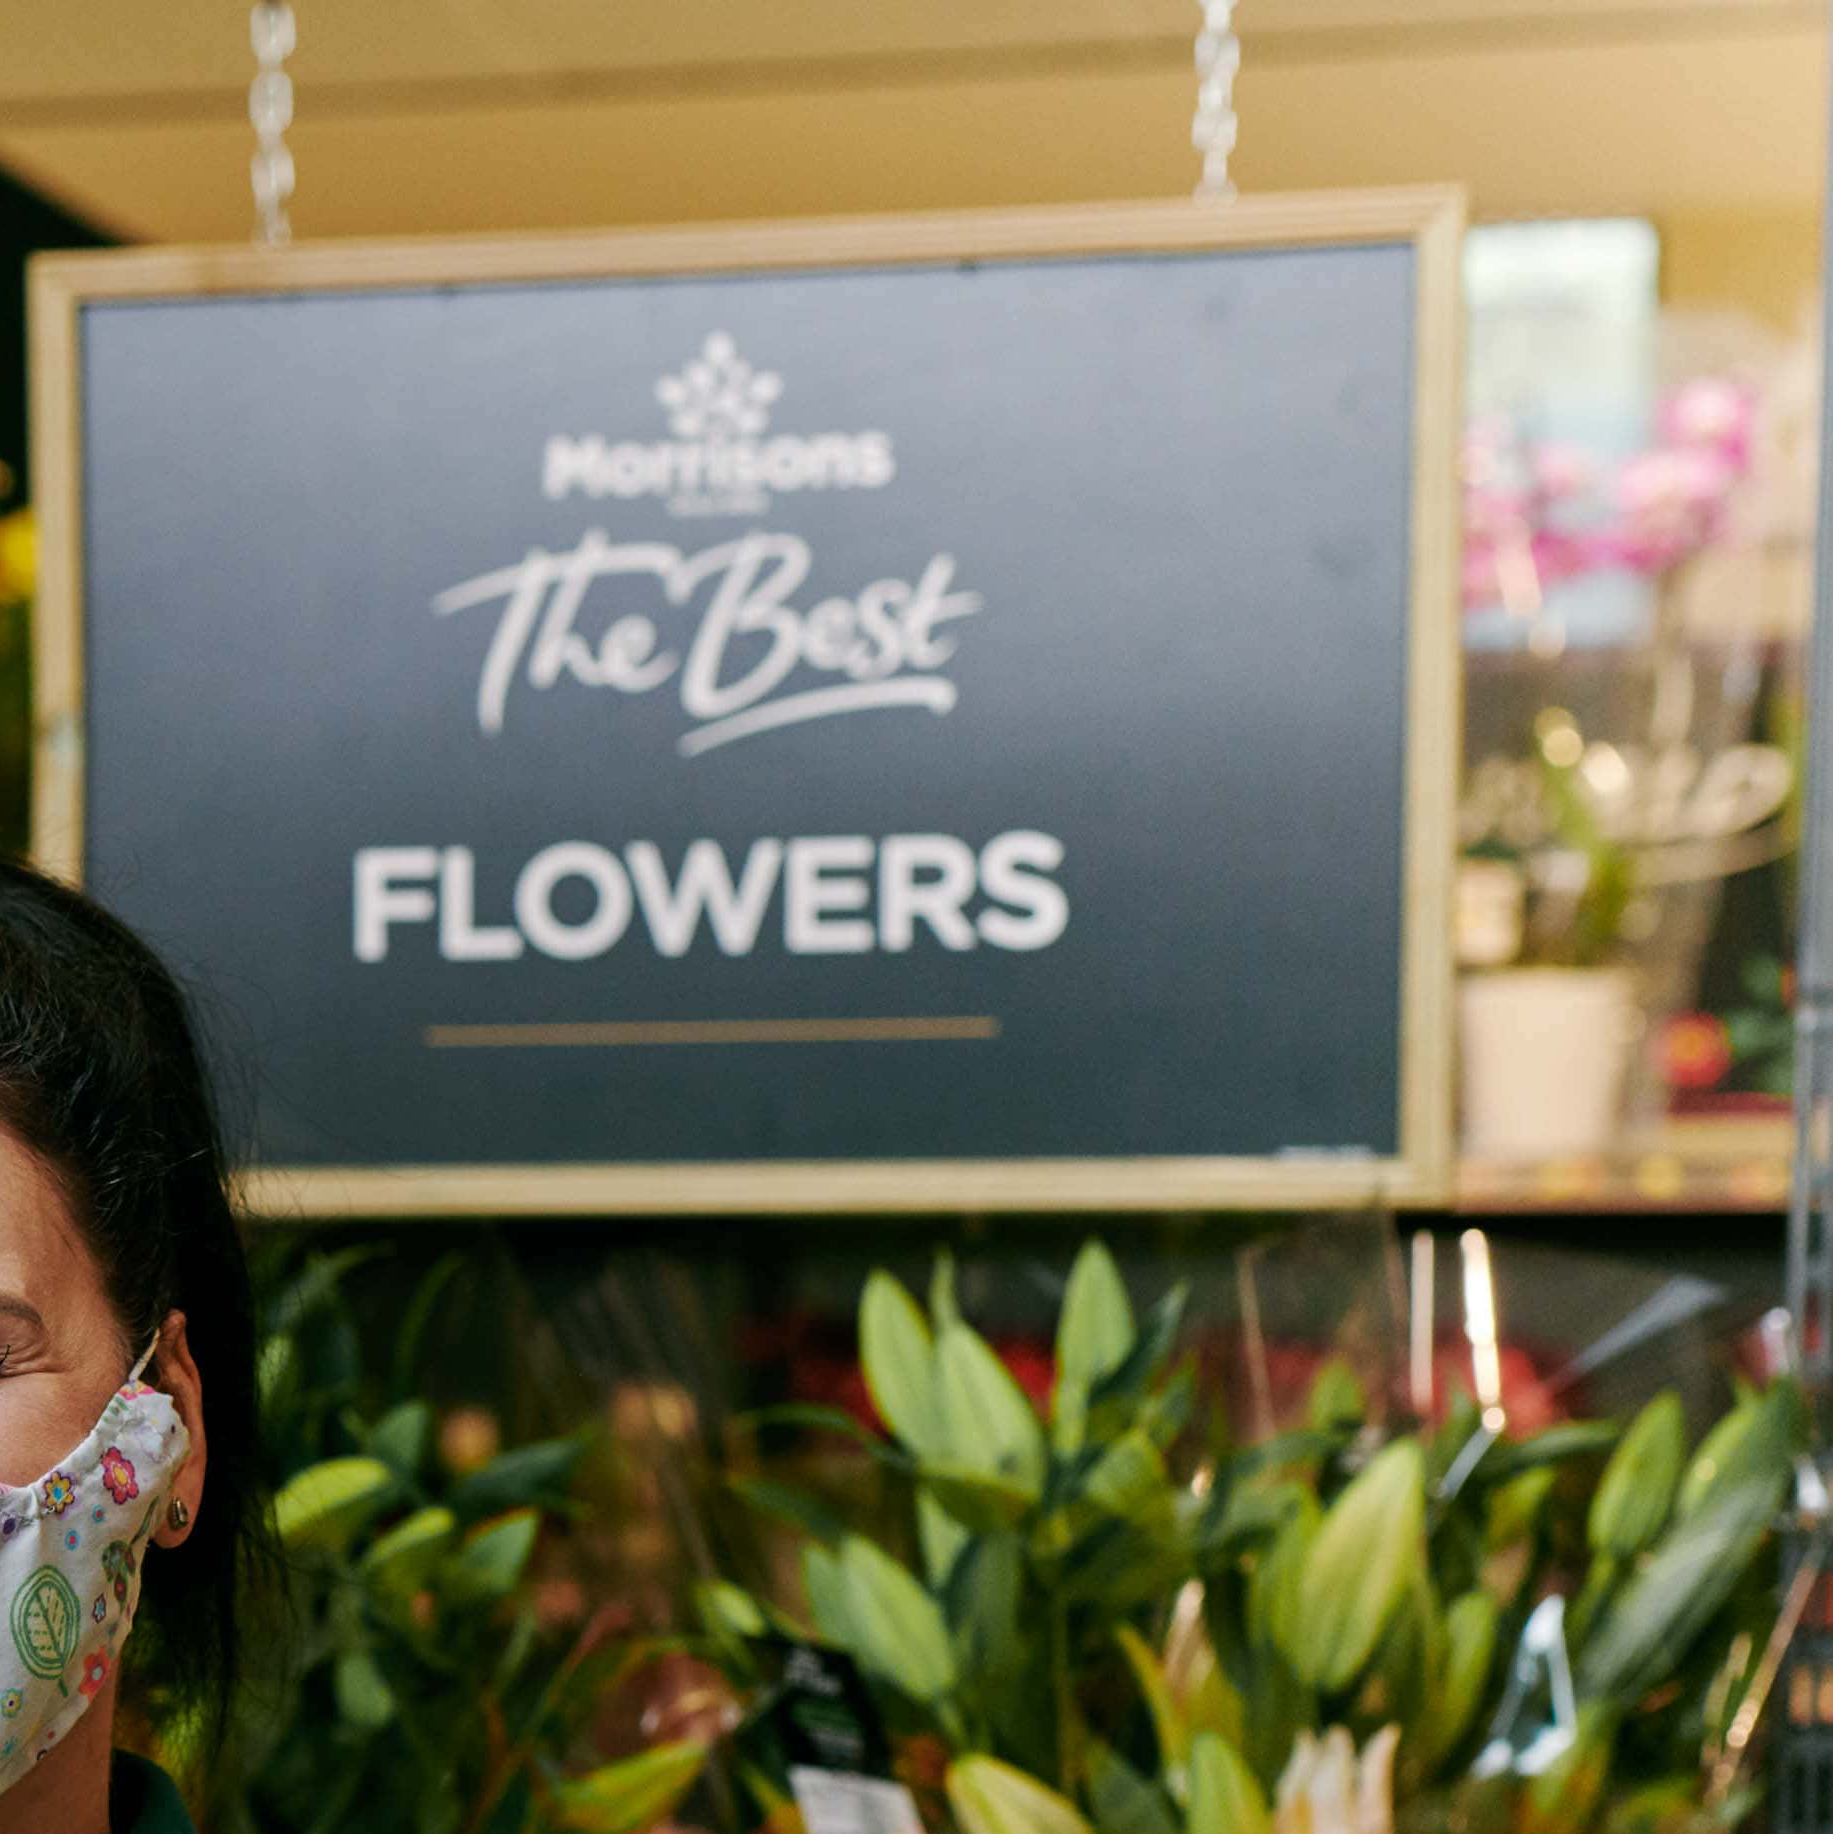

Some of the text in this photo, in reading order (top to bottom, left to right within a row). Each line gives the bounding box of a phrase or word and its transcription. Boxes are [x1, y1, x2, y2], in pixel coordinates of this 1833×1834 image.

[543, 432, 895, 499] Morrisons
[433, 527, 985, 737] The Best
[352, 829, 1071, 962] FLOWERS
